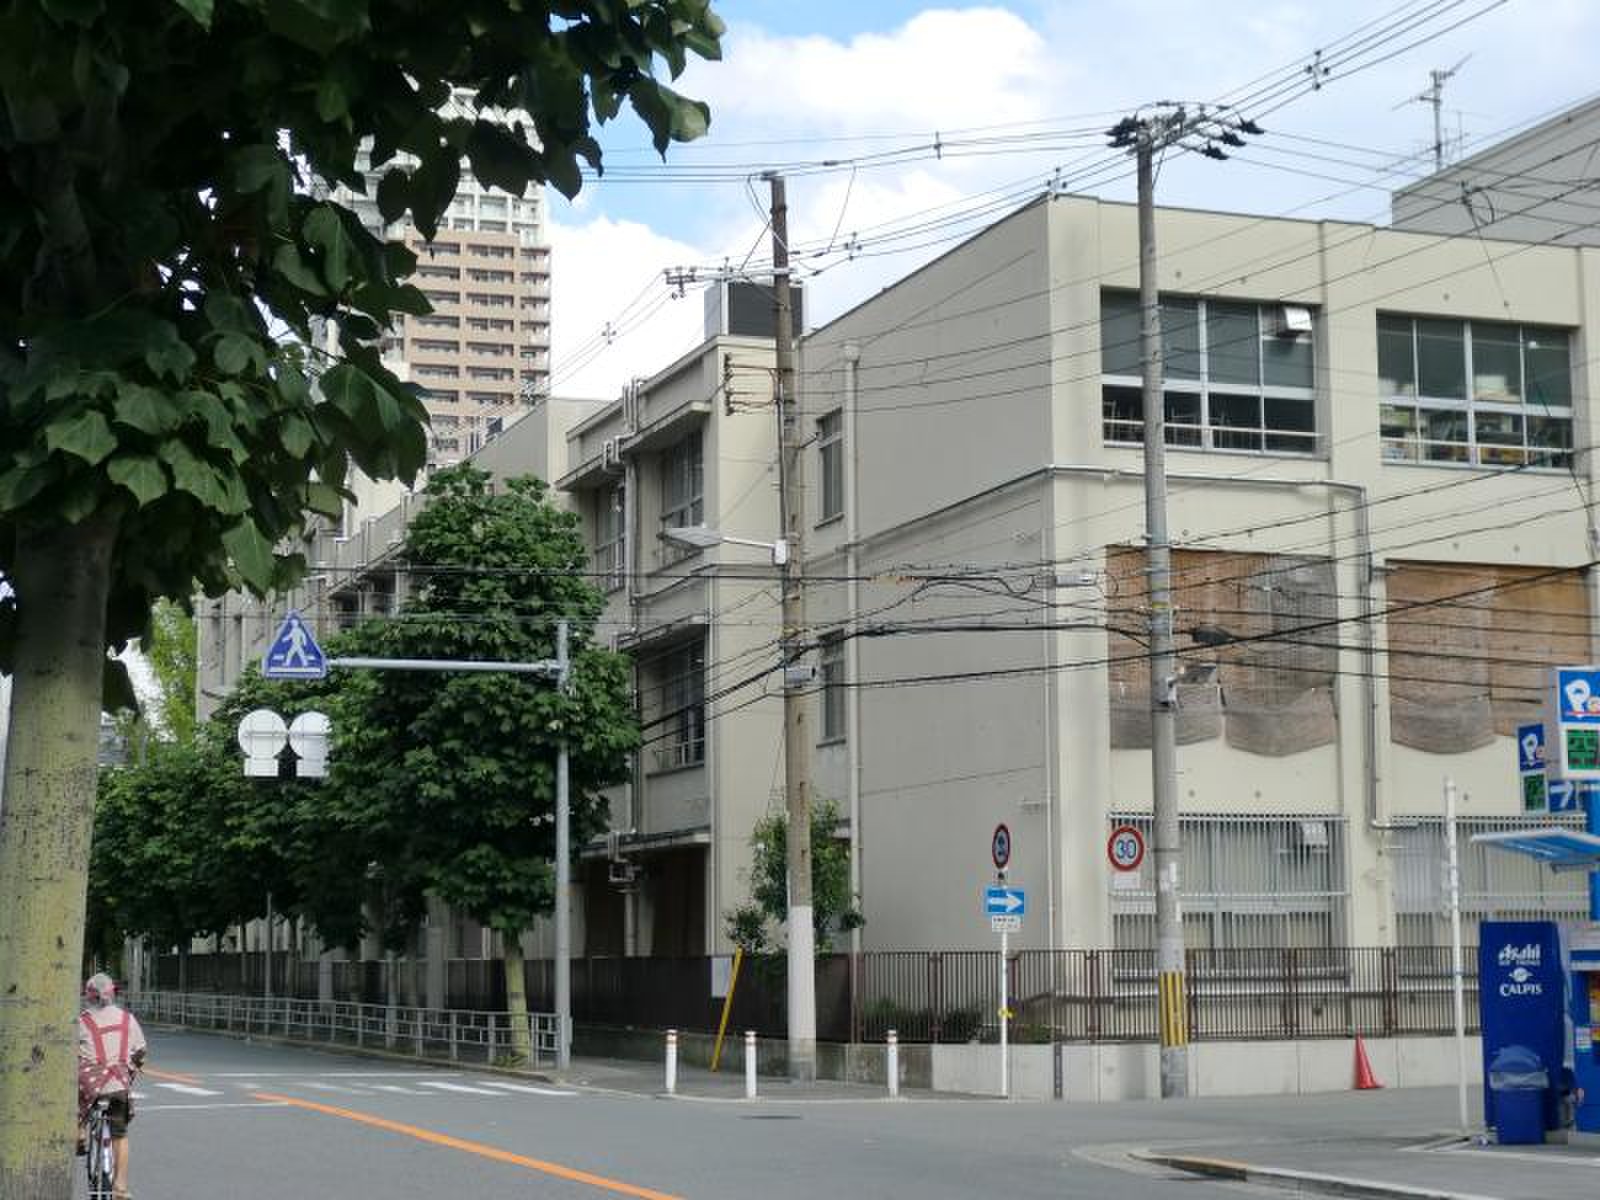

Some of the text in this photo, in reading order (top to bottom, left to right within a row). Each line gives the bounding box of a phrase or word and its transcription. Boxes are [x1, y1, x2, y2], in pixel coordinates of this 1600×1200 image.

[1117, 840, 1137, 859] 30
[1498, 944, 1541, 961] Asahi
[1500, 983, 1542, 997] CALPIS
